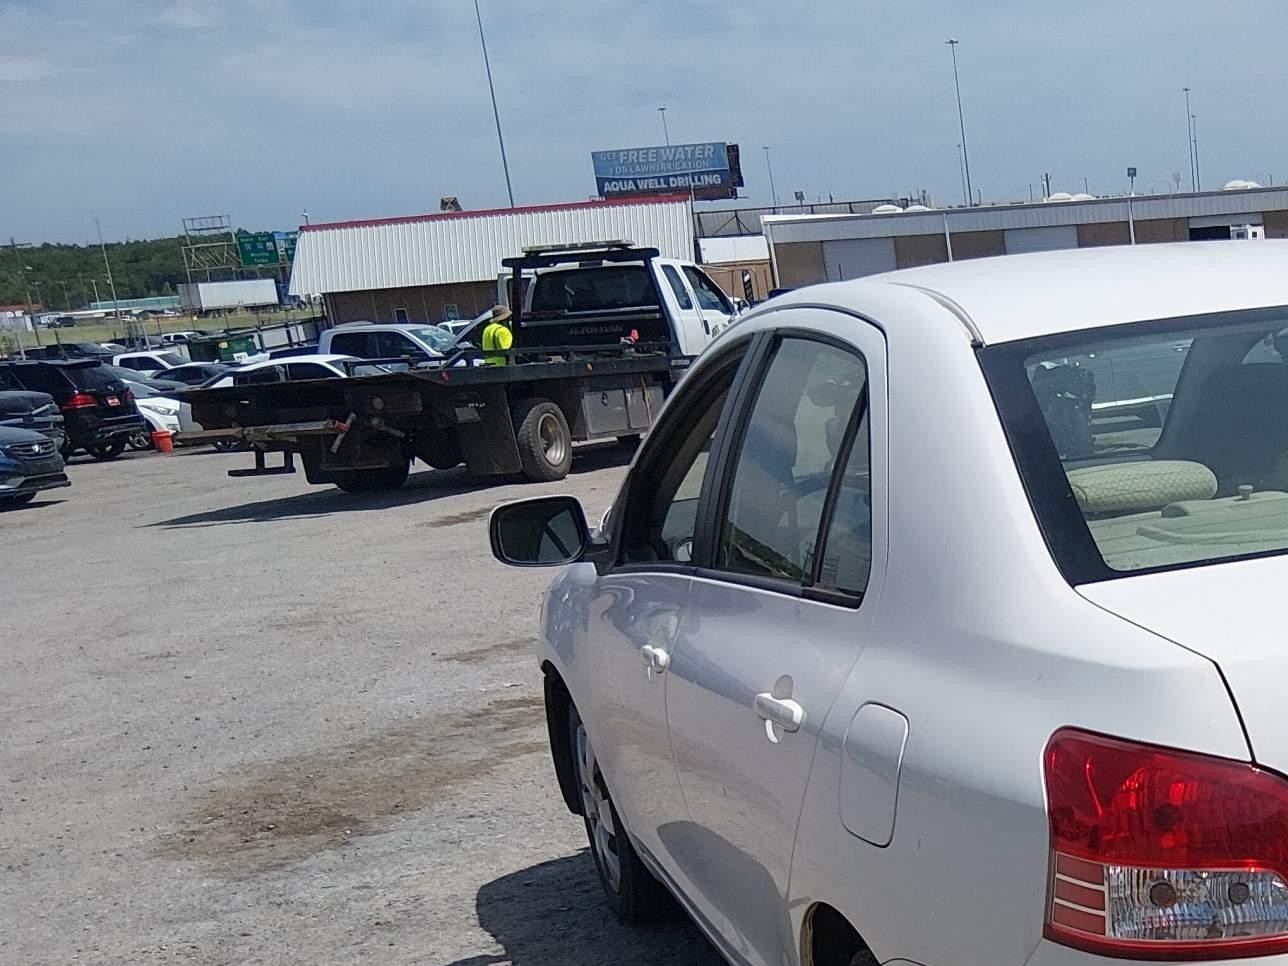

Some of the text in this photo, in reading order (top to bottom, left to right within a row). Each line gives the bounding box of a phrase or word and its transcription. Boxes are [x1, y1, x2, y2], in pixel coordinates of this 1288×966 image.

[620, 150, 657, 164] FREE
[662, 145, 714, 161] WATER
[609, 166, 628, 175] FOR
[604, 174, 721, 192] AQUA WELL DRILLING
